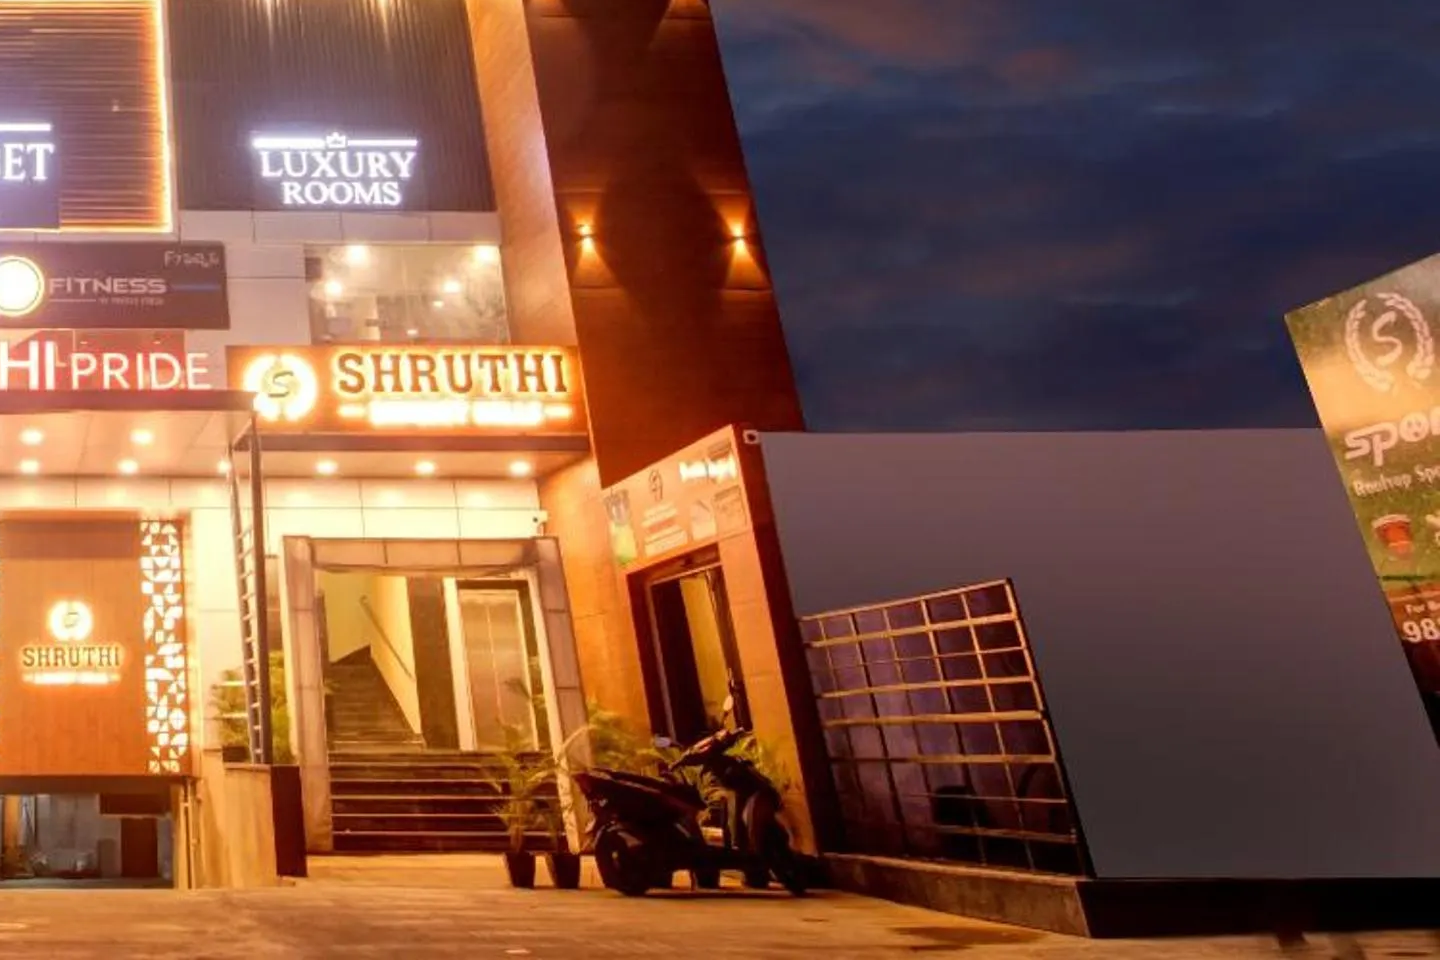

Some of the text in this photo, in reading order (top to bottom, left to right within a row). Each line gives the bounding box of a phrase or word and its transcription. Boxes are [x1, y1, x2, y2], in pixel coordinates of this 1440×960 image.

[259, 150, 417, 179] LUXURY
[281, 181, 403, 206] ROOMS
[48, 276, 168, 295] FITNESS
[70, 351, 213, 391] PRIDE
[337, 353, 568, 395] SHRUTHI
[22, 646, 121, 668] SHRUTHI
